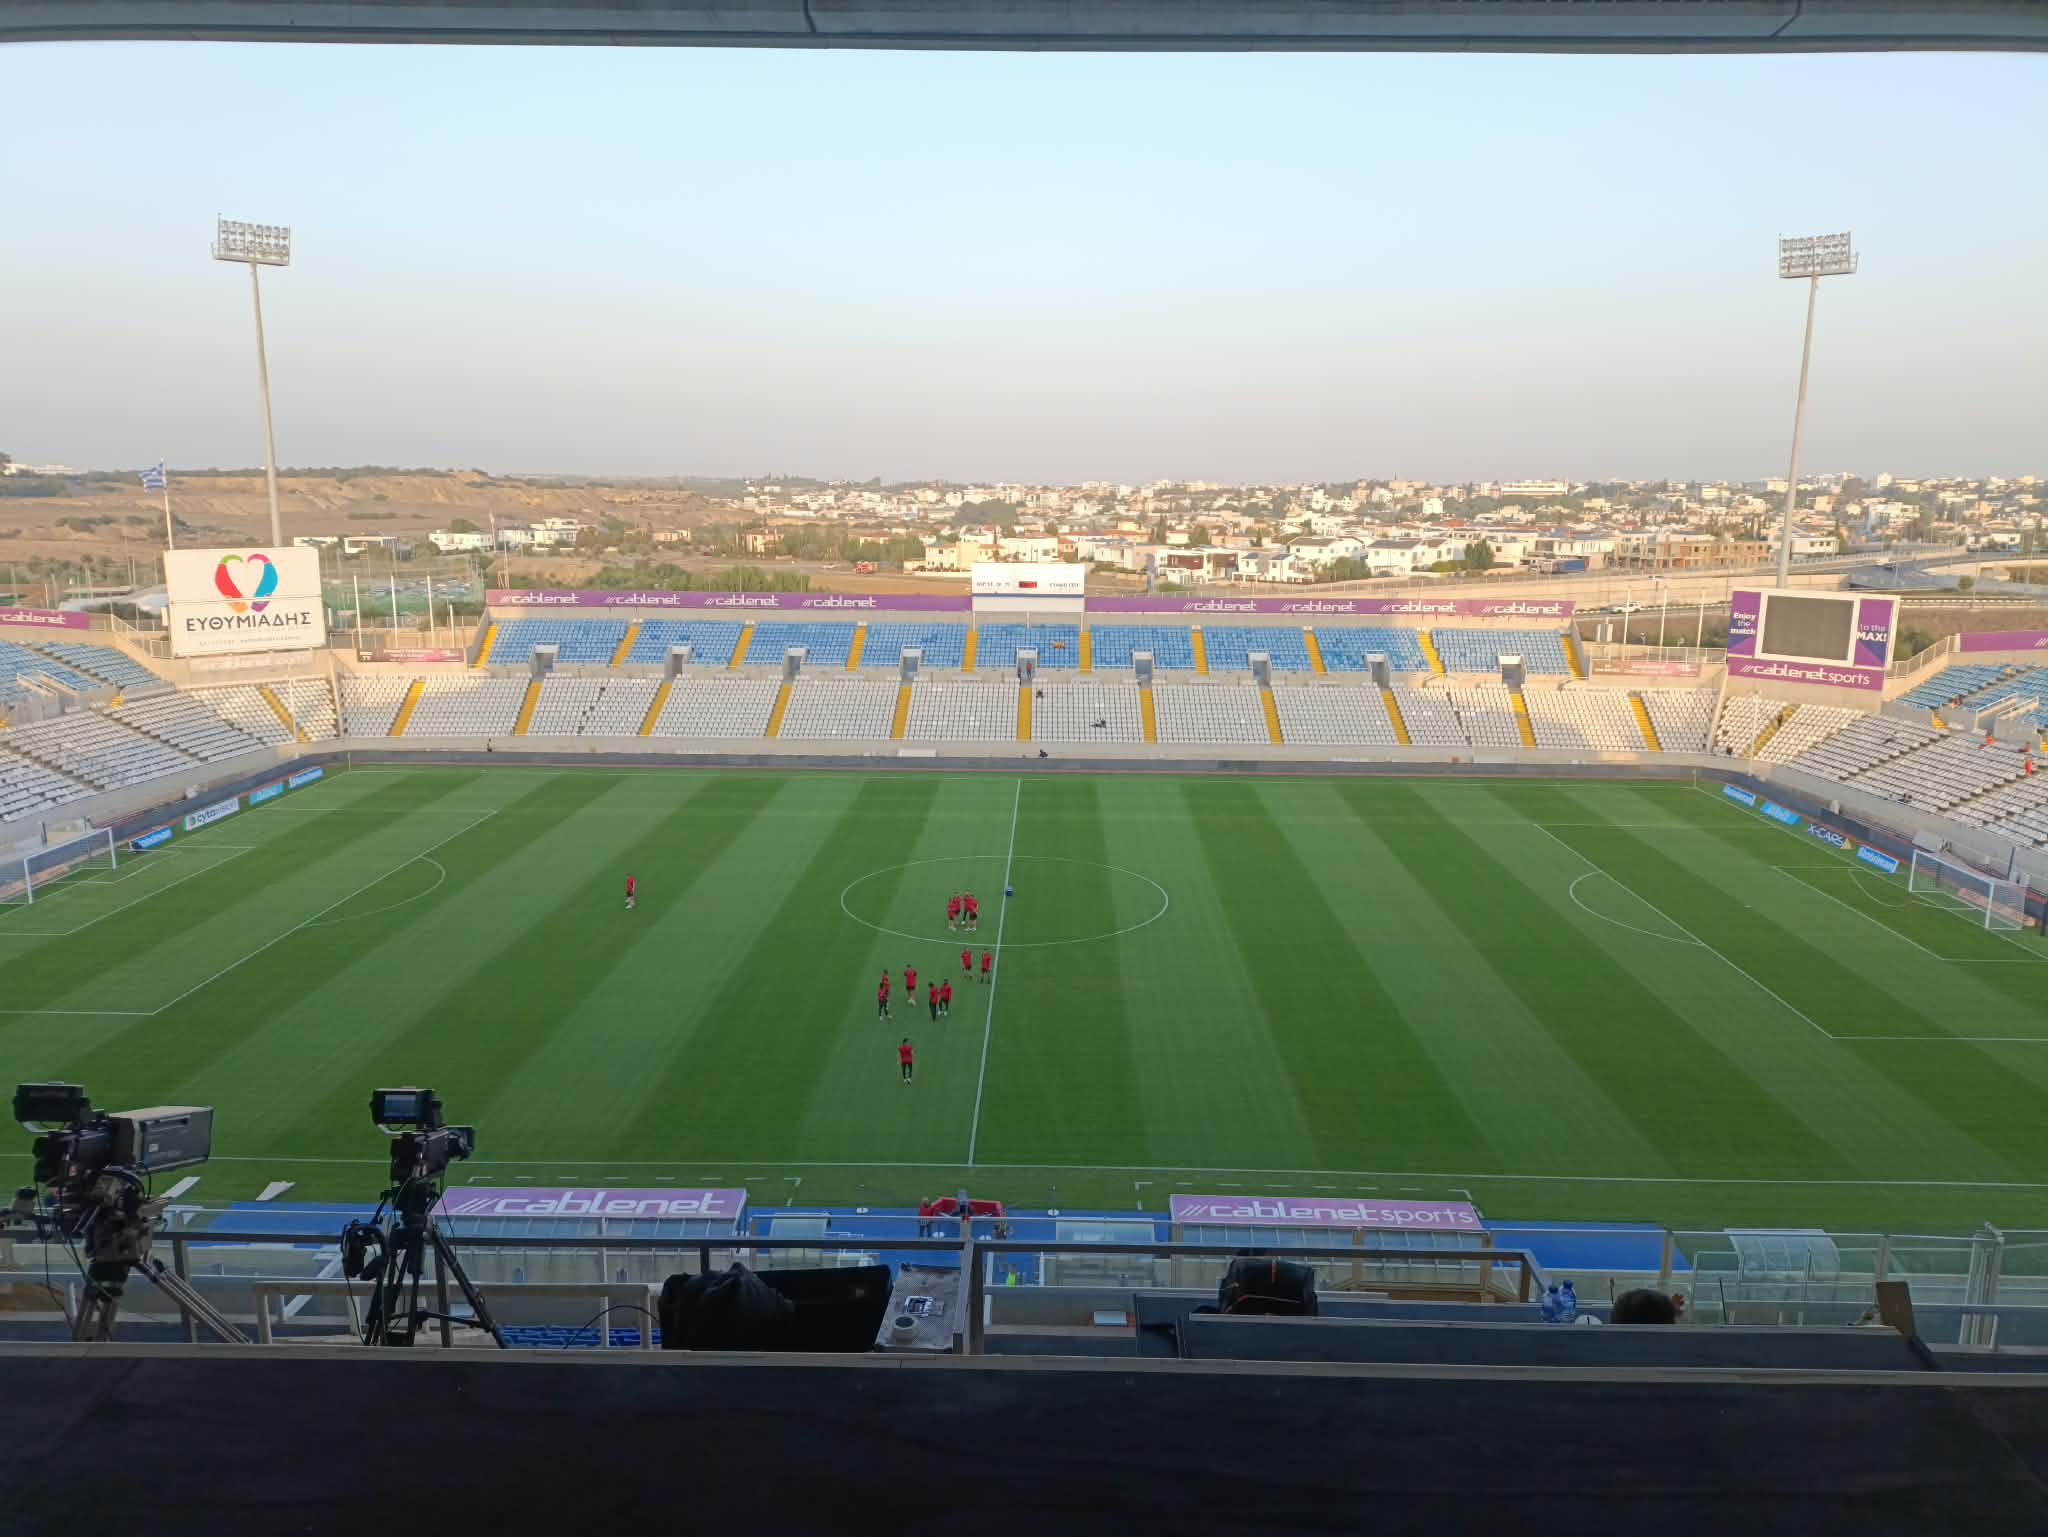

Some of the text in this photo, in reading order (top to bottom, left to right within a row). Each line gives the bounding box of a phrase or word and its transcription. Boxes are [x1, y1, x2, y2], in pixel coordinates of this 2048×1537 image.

[511, 592, 579, 604] cablenet
[615, 593, 681, 605] cablenet
[715, 594, 780, 607] cablenet
[813, 595, 877, 608] cablenet
[1194, 600, 1257, 612] cablenet
[1292, 600, 1357, 612] cablenet
[1391, 600, 1456, 613] cablenet
[1494, 601, 1564, 614] cablenet
[186, 611, 312, 632] ΕΥΘΥΜΙΑΔΗΣ
[1733, 612, 1756, 621] Enjoy
[1856, 631, 1888, 642] MAX!
[494, 1191, 726, 1216] cablenet
